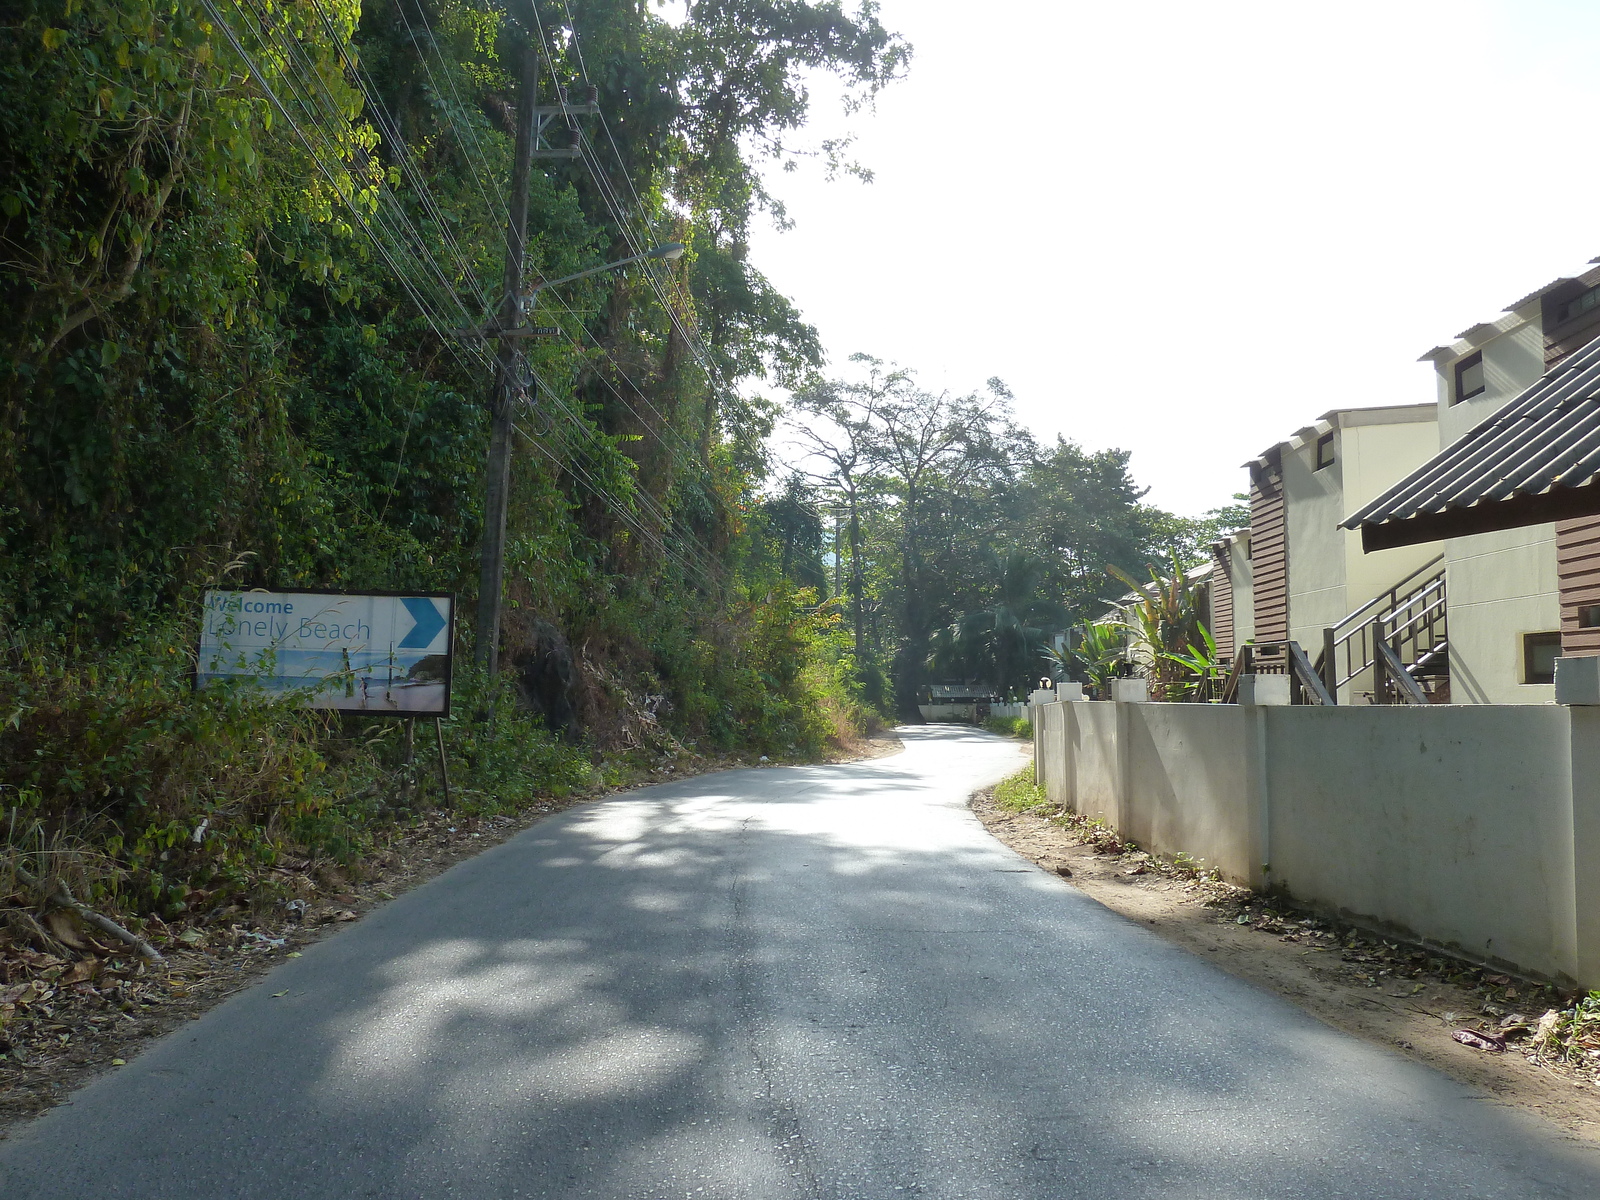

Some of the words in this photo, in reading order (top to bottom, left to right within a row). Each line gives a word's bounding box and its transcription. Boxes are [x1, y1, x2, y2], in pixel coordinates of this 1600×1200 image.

[209, 596, 294, 614] Welcome
[209, 614, 288, 640] Lonely
[300, 617, 370, 640] Beach
